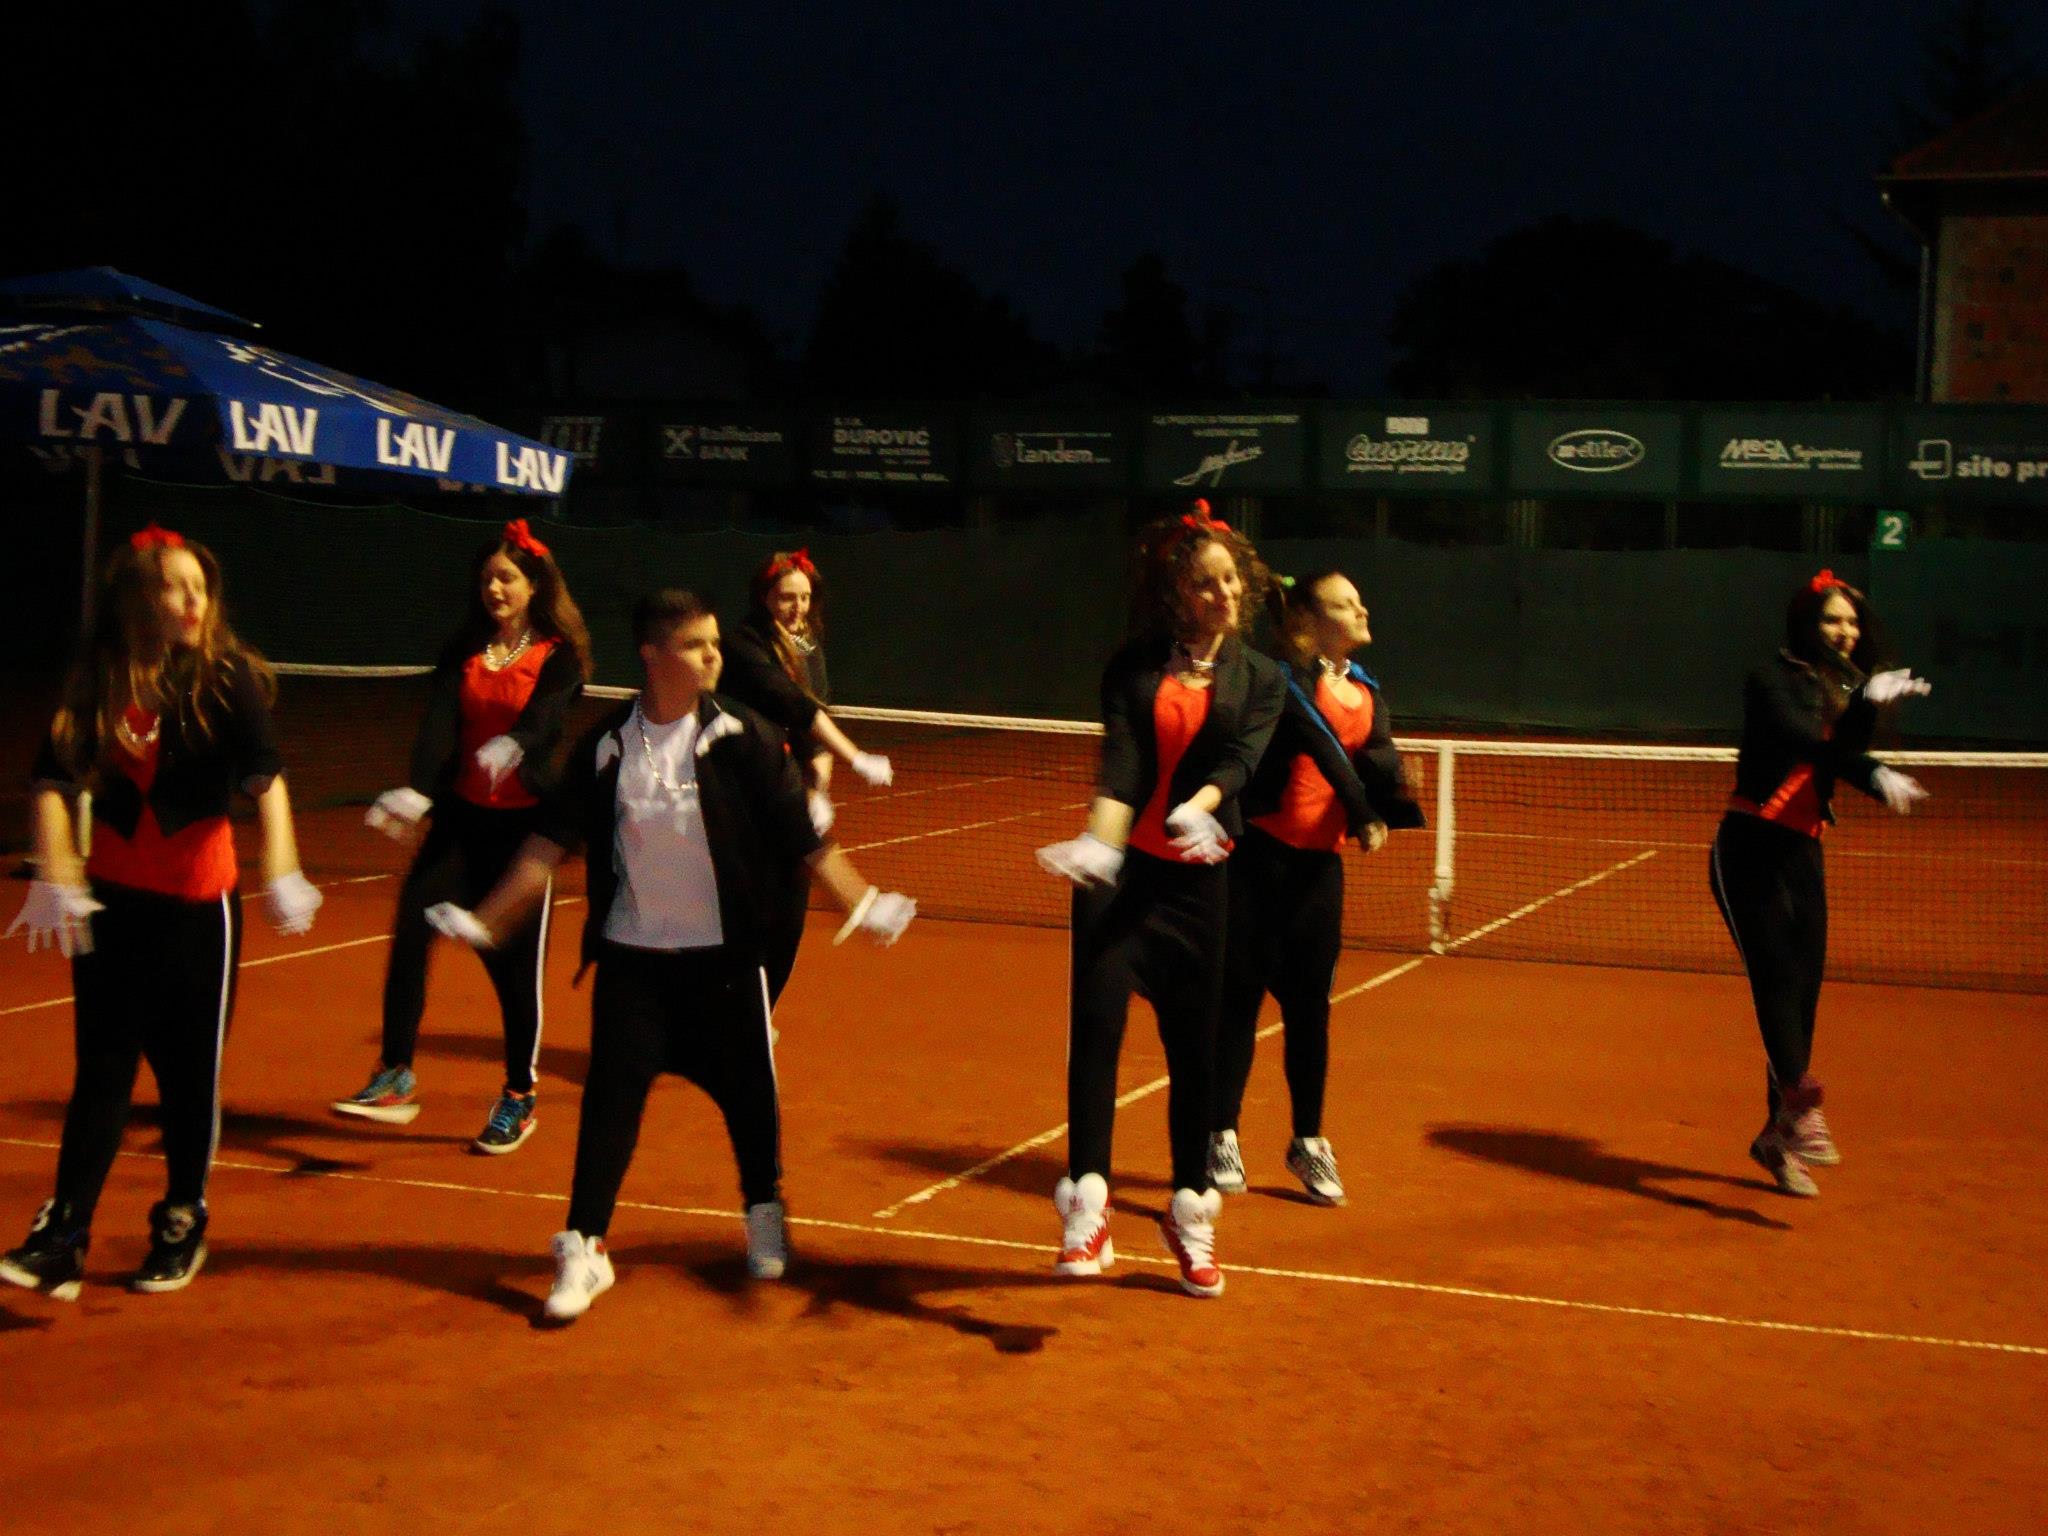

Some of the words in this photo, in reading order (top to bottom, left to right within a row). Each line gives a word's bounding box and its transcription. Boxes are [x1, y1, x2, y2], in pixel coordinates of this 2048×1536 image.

[40, 389, 188, 445] LAV
[230, 401, 319, 456] LAV
[376, 418, 456, 473] LAV
[496, 441, 567, 493] LAV
[1956, 454, 2012, 478] sito
[1881, 515, 1903, 545] 2
